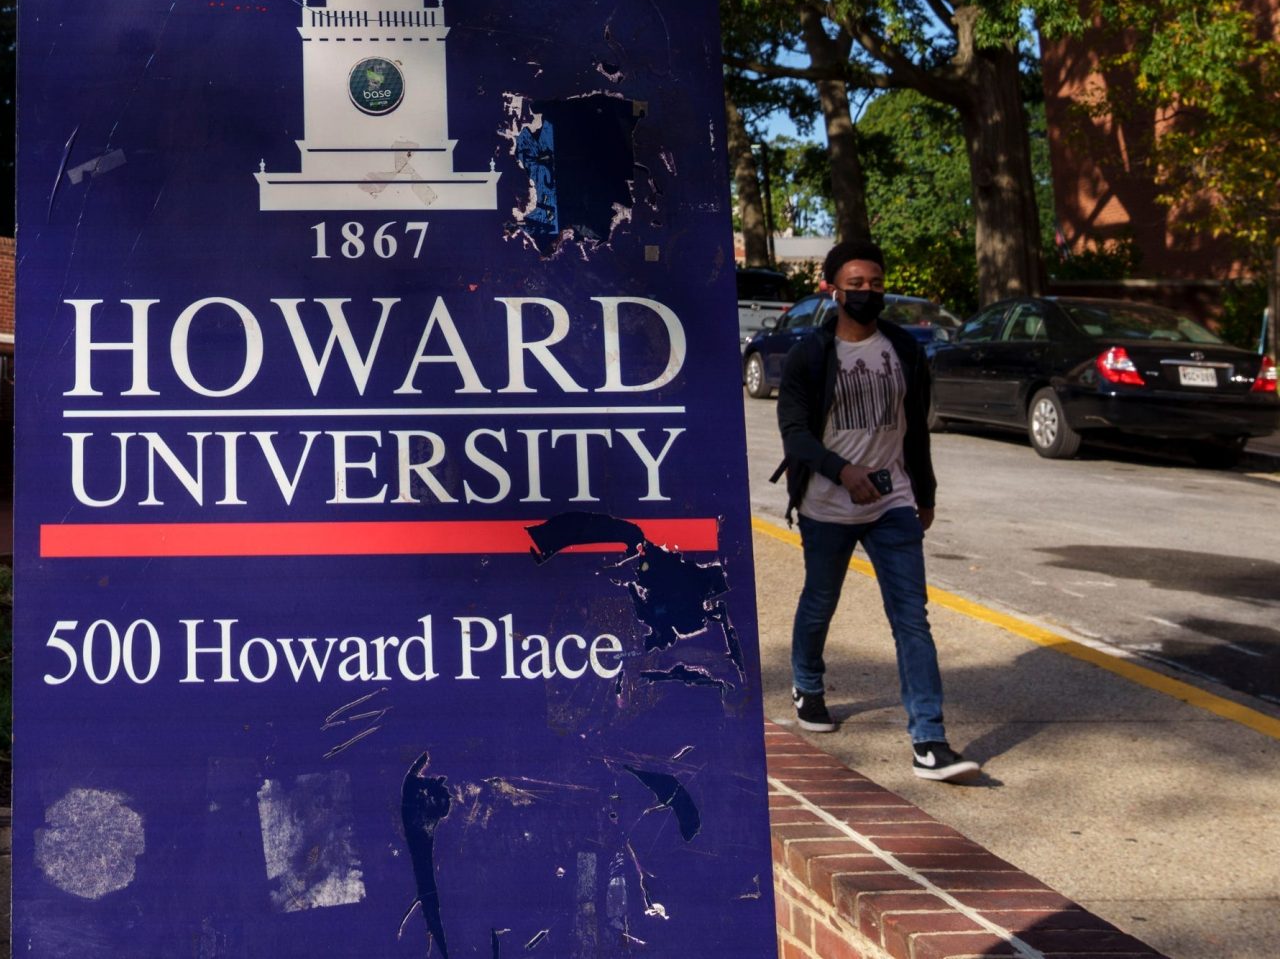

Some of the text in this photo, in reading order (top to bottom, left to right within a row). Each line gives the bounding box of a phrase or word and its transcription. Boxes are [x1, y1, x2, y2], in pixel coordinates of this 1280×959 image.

[363, 89, 392, 99] base
[311, 221, 429, 259] 1867
[62, 296, 686, 398] HOWARD
[62, 428, 686, 507] UNIVERSITY
[43, 613, 624, 685] 500 Howard Place
